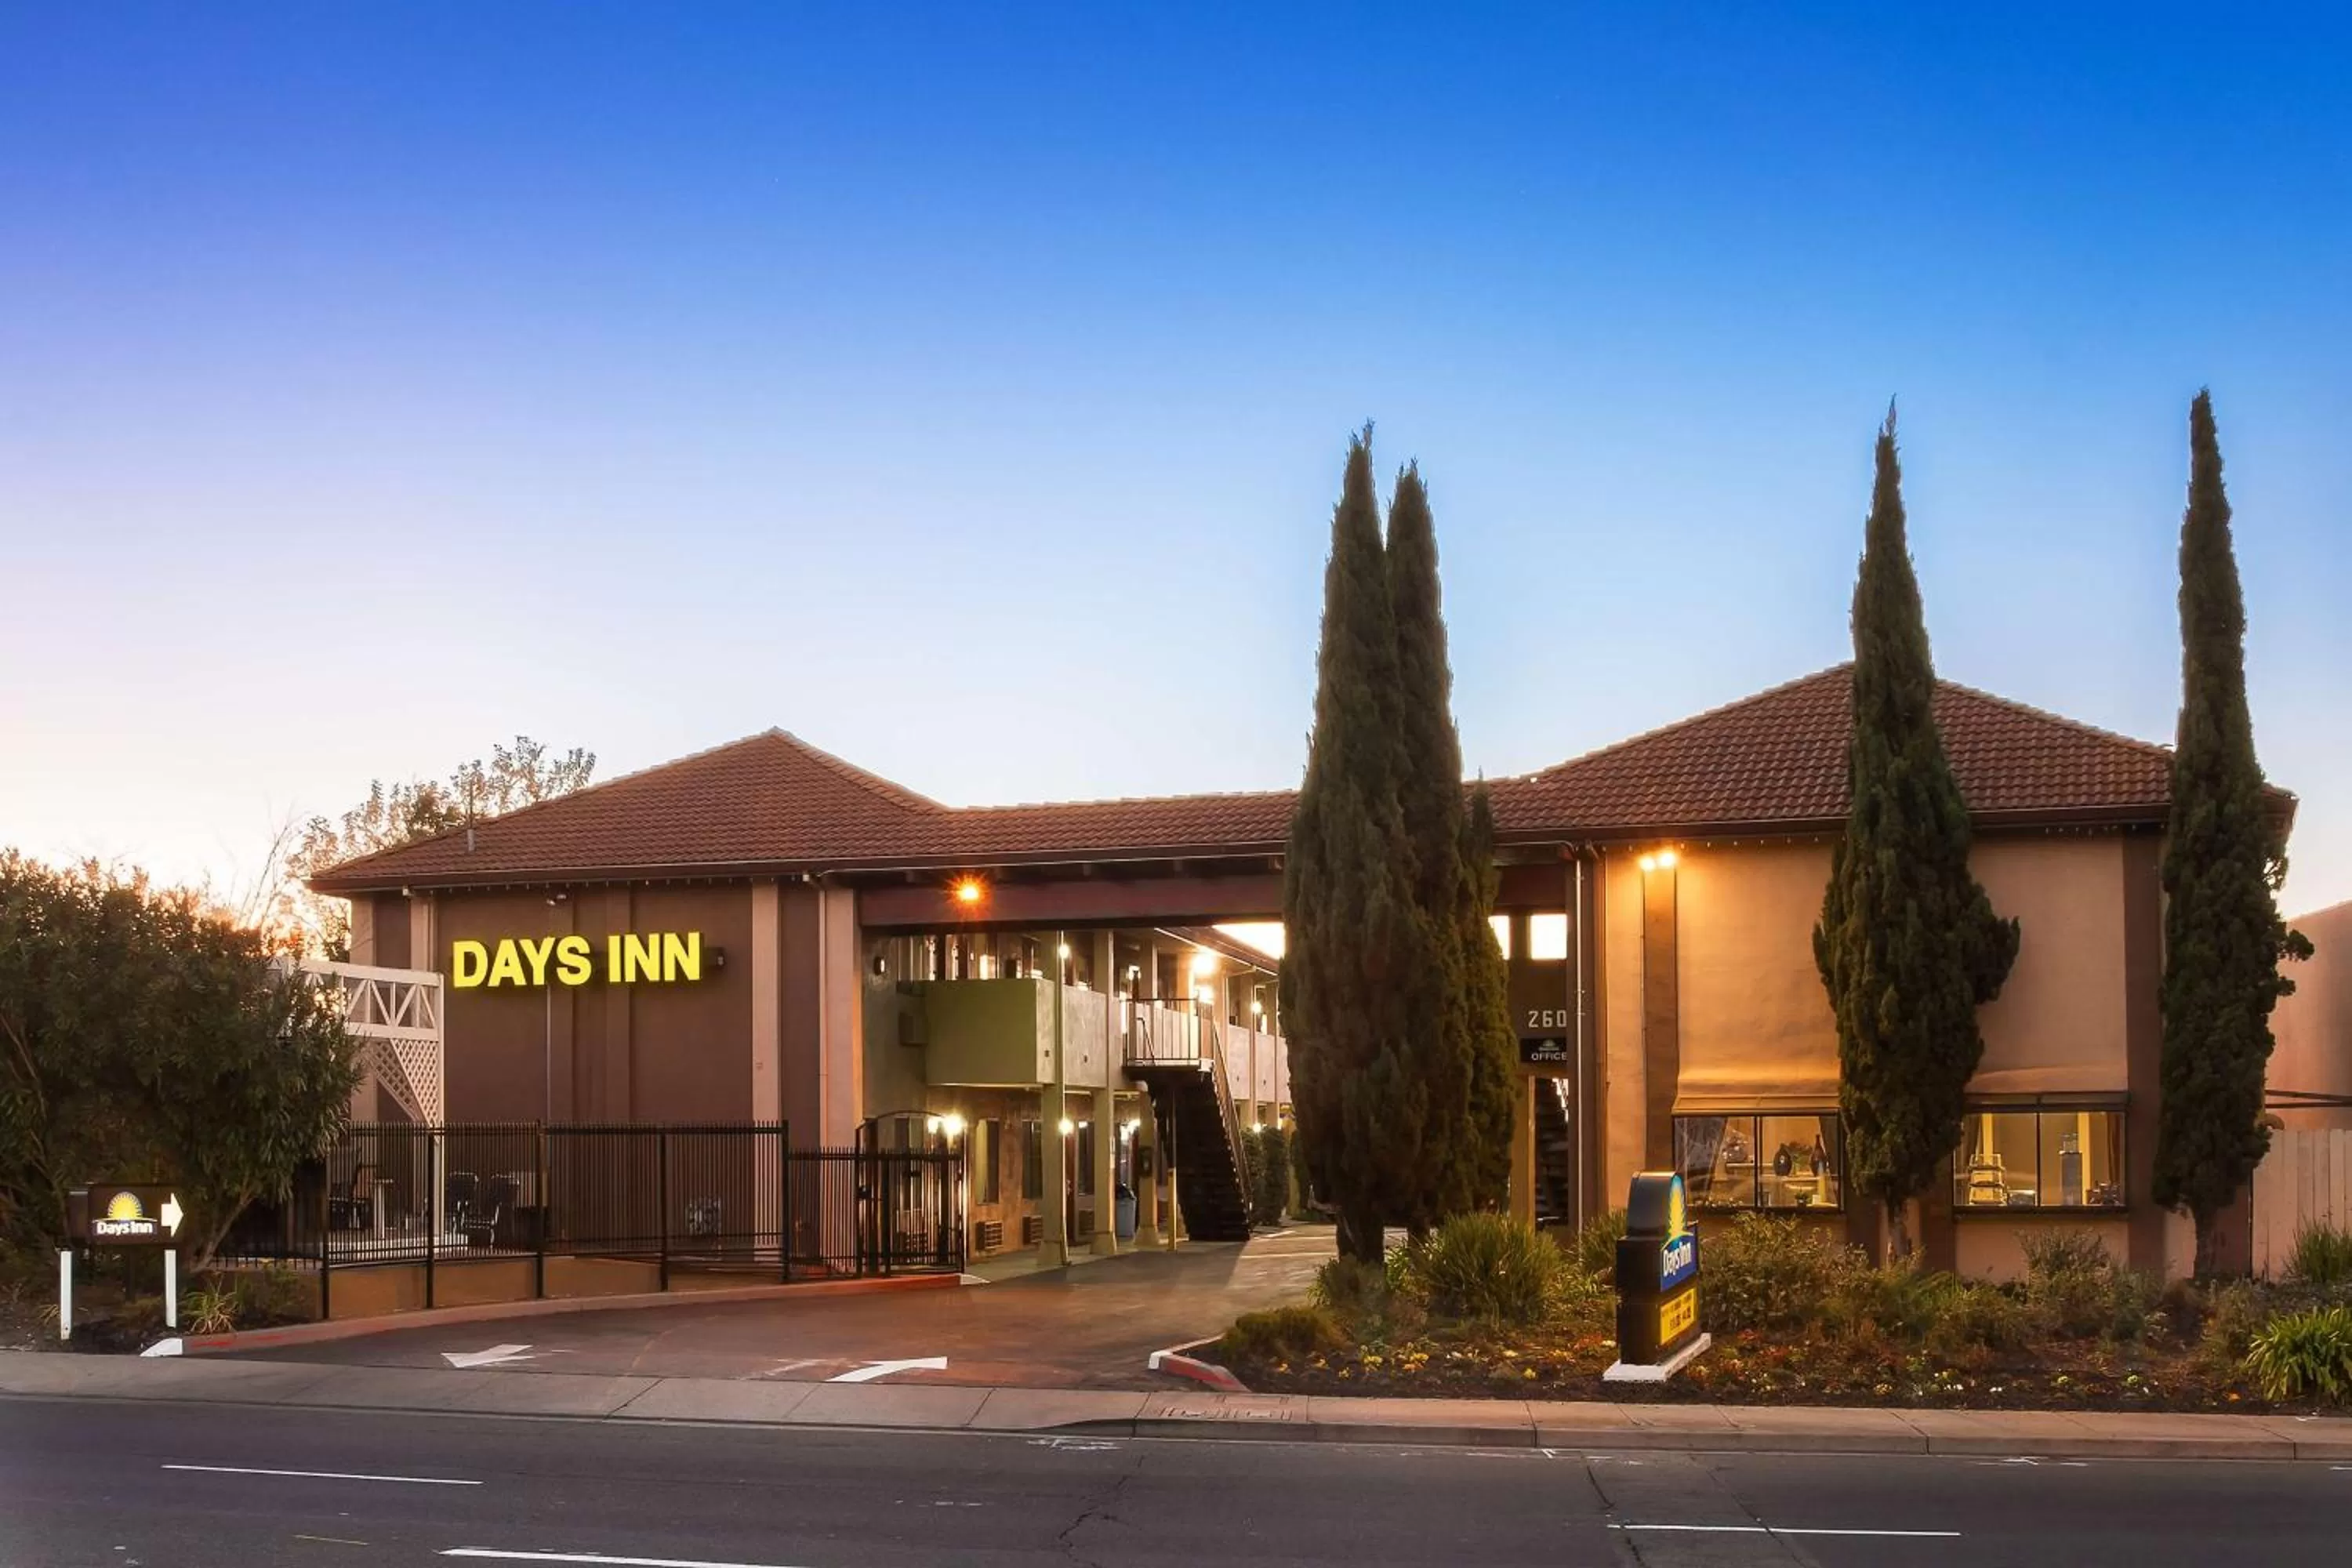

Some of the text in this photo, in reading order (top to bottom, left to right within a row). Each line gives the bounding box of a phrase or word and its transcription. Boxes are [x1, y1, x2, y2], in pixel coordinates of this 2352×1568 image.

[453, 931, 700, 987] DAYS INN
[96, 1221, 153, 1236] Days Inn
[1663, 1241, 1691, 1276] Days Inn
